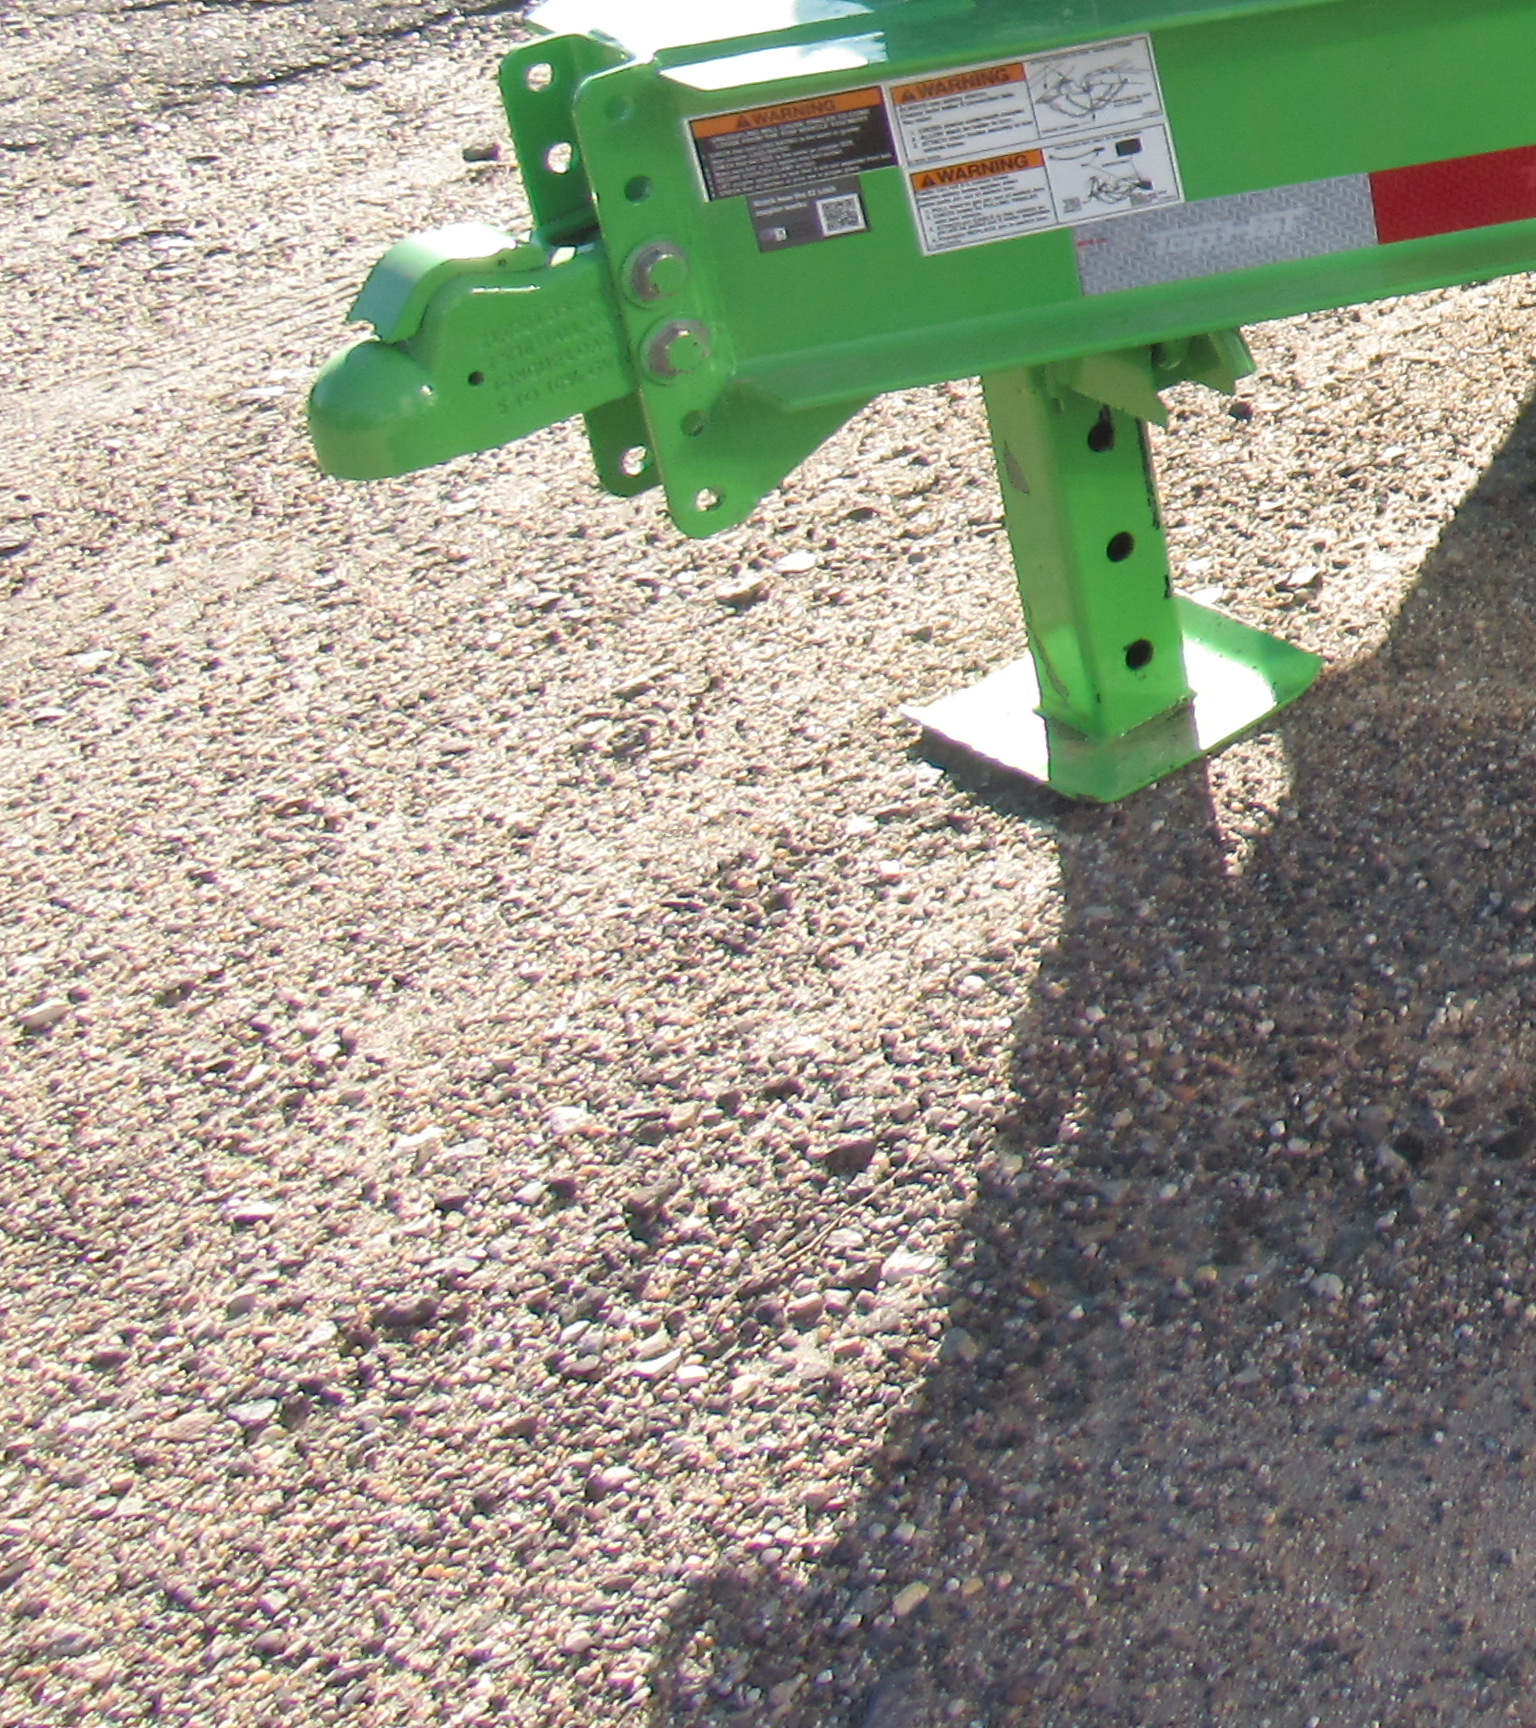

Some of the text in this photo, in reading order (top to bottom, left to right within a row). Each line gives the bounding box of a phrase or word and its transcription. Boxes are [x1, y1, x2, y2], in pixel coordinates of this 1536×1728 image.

[918, 68, 1010, 96] WARNING
[753, 100, 836, 126] WARNING
[937, 154, 1029, 184] WARNING
